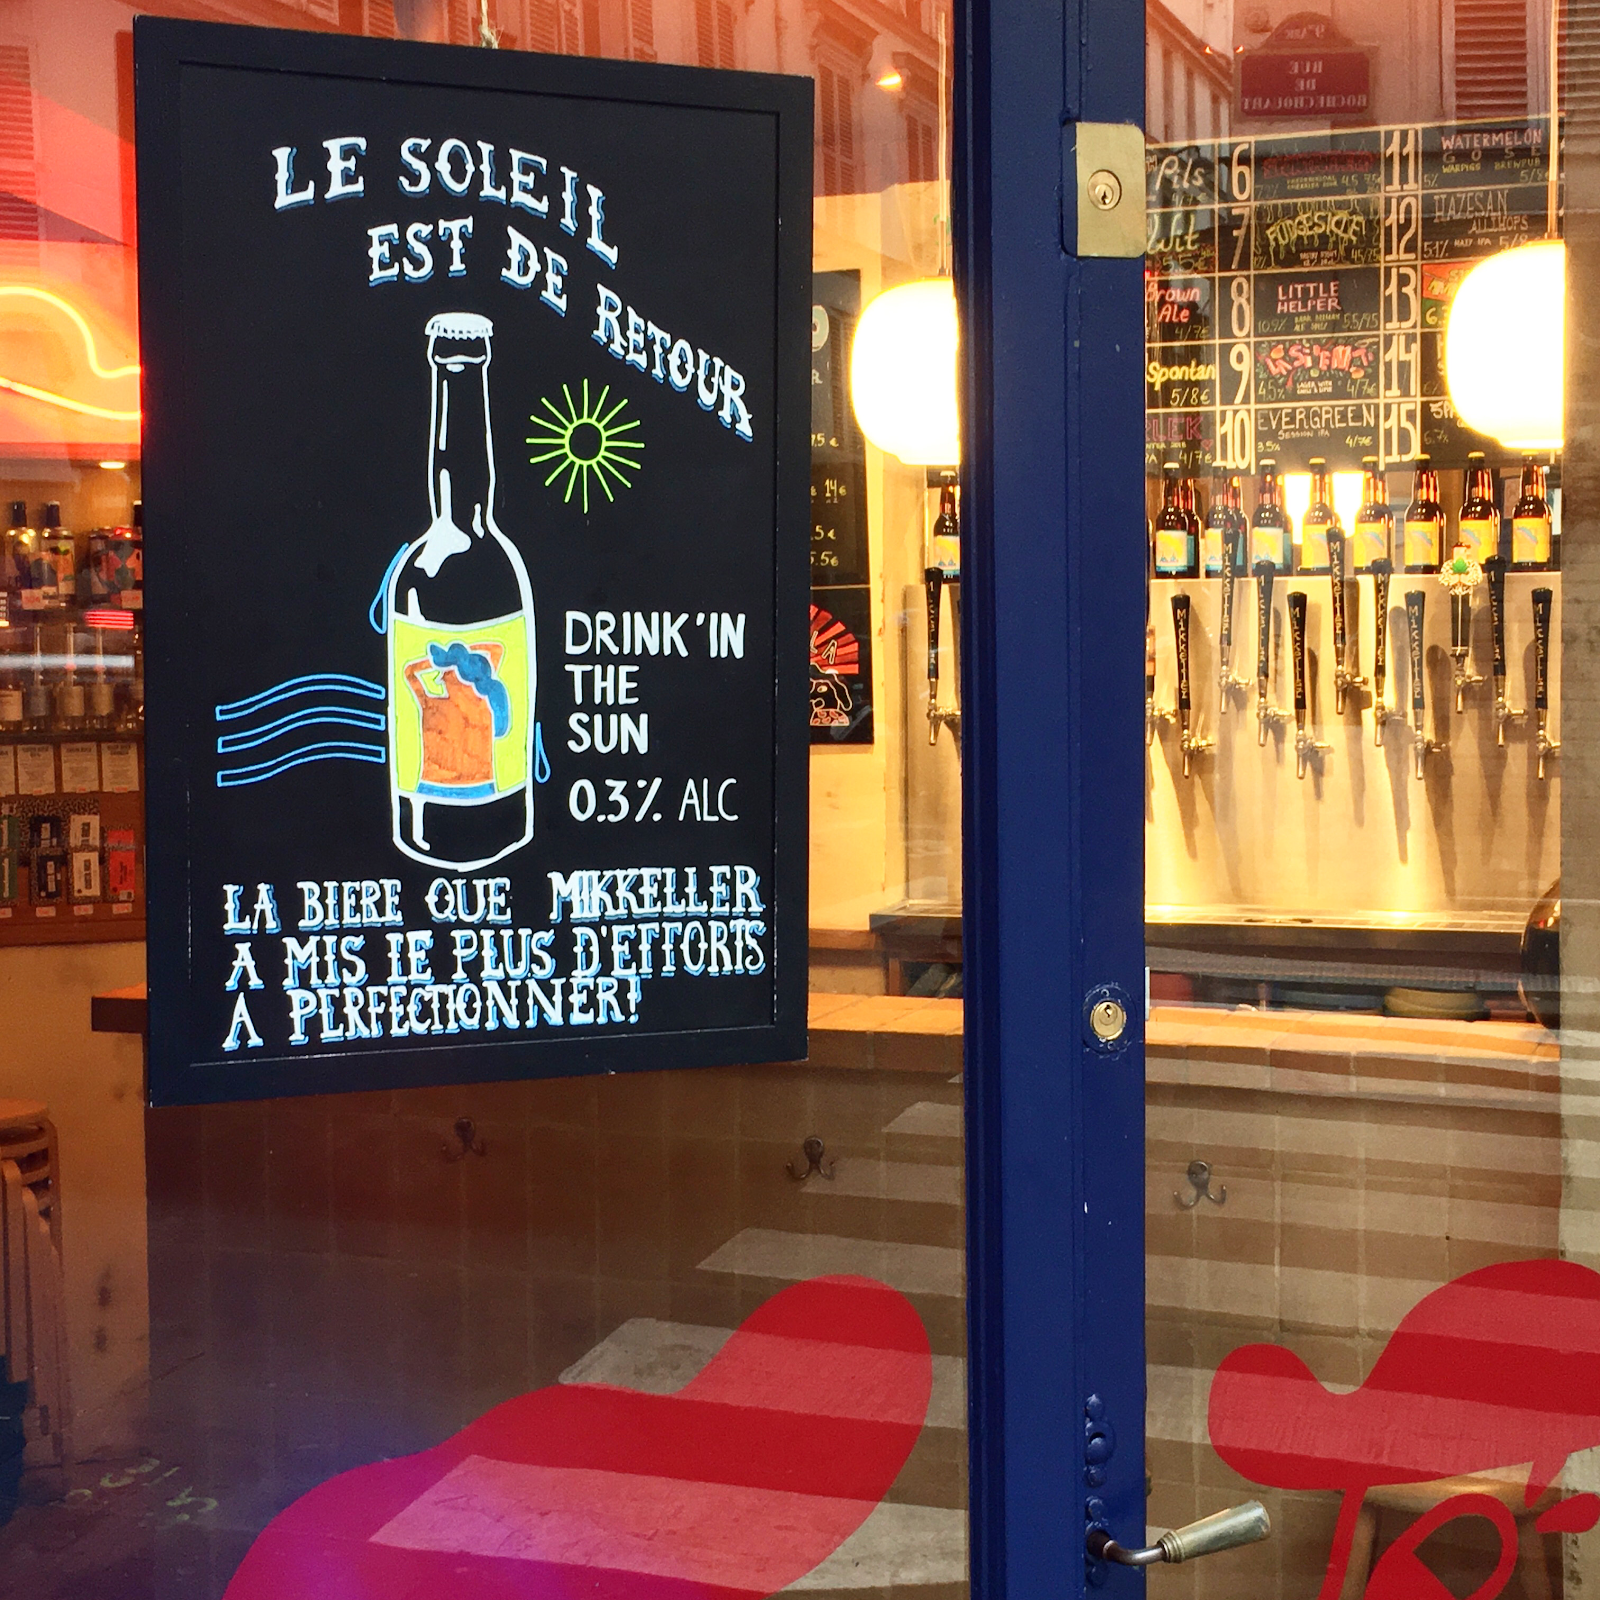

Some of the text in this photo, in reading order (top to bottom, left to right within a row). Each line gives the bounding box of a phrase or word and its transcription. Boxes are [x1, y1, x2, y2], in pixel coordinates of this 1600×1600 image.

[1385, 130, 1418, 191] 11
[1441, 128, 1542, 150] WATERMELON
[1231, 143, 1250, 200] 6
[272, 136, 619, 268] LE SOLEIL
[1385, 196, 1417, 261] 12
[367, 215, 568, 317] EST DE
[1231, 207, 1250, 269] 7
[1158, 303, 1190, 323] Ale
[1230, 276, 1250, 337] 8
[1277, 298, 1342, 314] HELPER
[1278, 281, 1340, 300] LITTLE
[1385, 267, 1417, 329] 13
[591, 283, 754, 442] RETOUR
[1147, 359, 1216, 391] Spontan
[1230, 343, 1250, 404] 9
[1385, 336, 1417, 396] 14
[1220, 409, 1251, 469] 10
[1258, 404, 1375, 431] EVERGREEN
[1385, 403, 1417, 464] 15
[564, 664, 640, 706] THE
[567, 712, 649, 755] SUN
[568, 777, 739, 823] 0.3% ALC
[223, 865, 766, 935] LA BIERE QUE MIKKELLER
[225, 942, 265, 991] A
[282, 934, 369, 991] MIS
[450, 927, 556, 983] PLUS
[222, 992, 264, 1051] A
